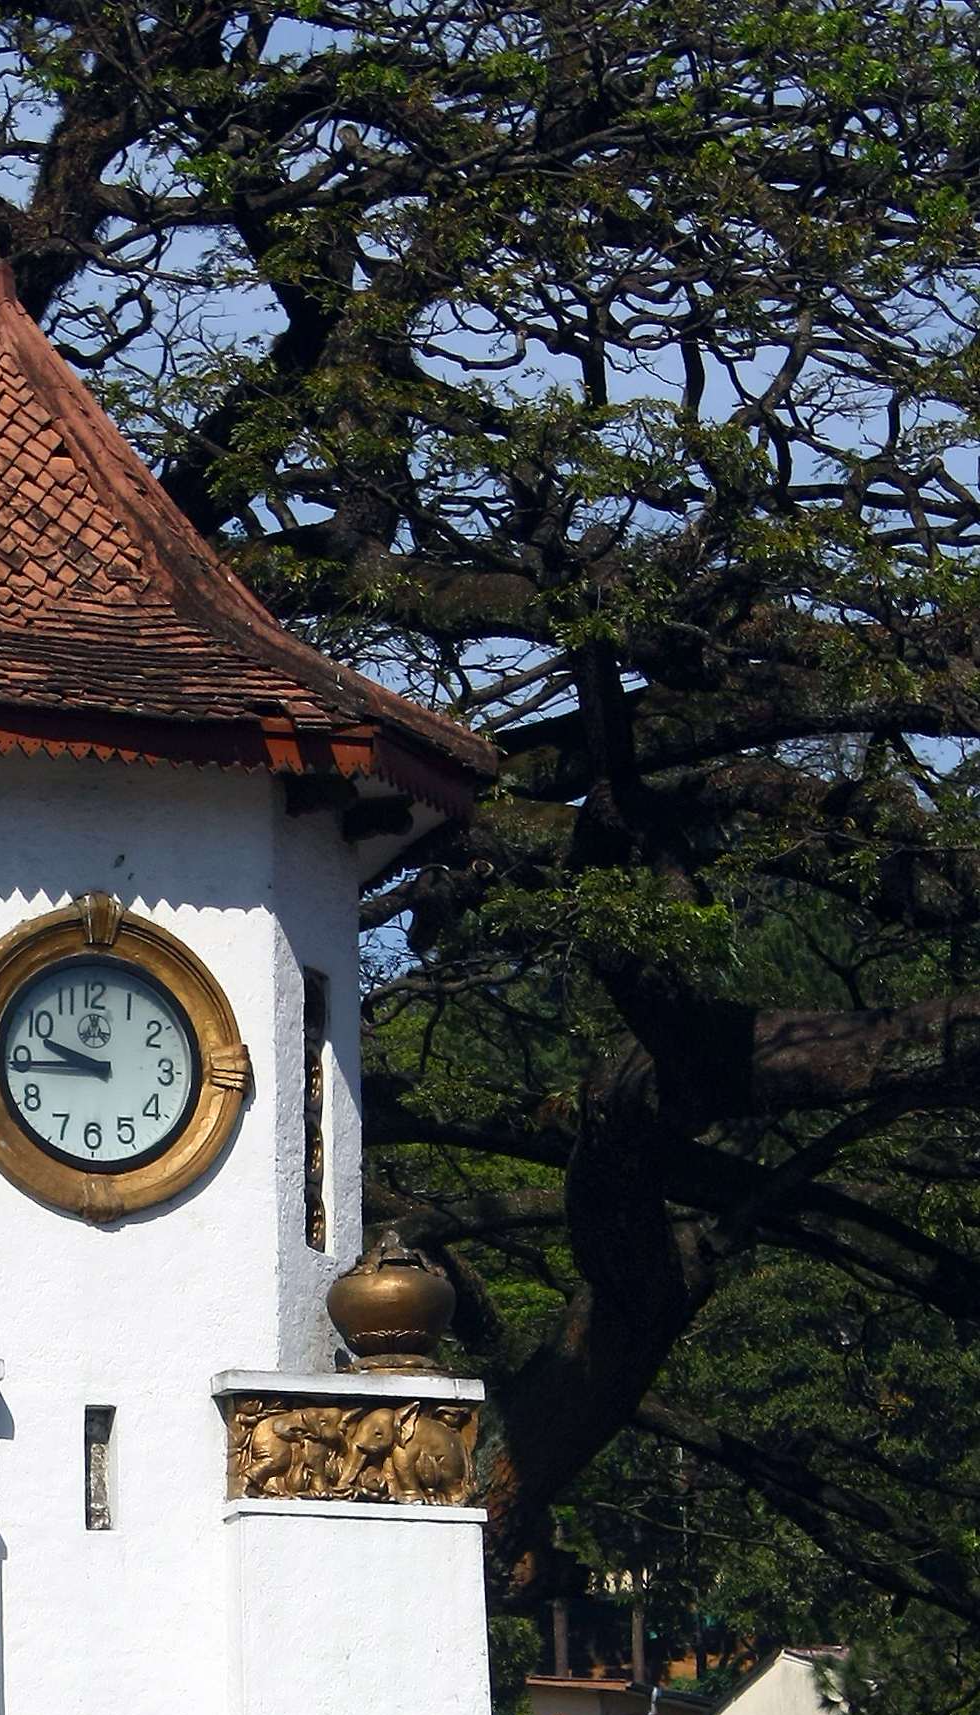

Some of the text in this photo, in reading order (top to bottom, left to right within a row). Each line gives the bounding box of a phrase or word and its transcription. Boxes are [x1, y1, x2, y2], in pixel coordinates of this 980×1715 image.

[58, 987, 74, 1015] 11
[84, 981, 106, 1010] 12
[127, 993, 132, 1021] 1
[28, 1010, 54, 1038] 10
[145, 1020, 163, 1049] 2
[13, 1045, 32, 1073] 9
[157, 1058, 175, 1086] 3
[24, 1083, 41, 1112] 8
[142, 1093, 161, 1121] 4
[52, 1113, 70, 1140] 7
[83, 1121, 102, 1150] 6
[117, 1116, 135, 1145] 5
